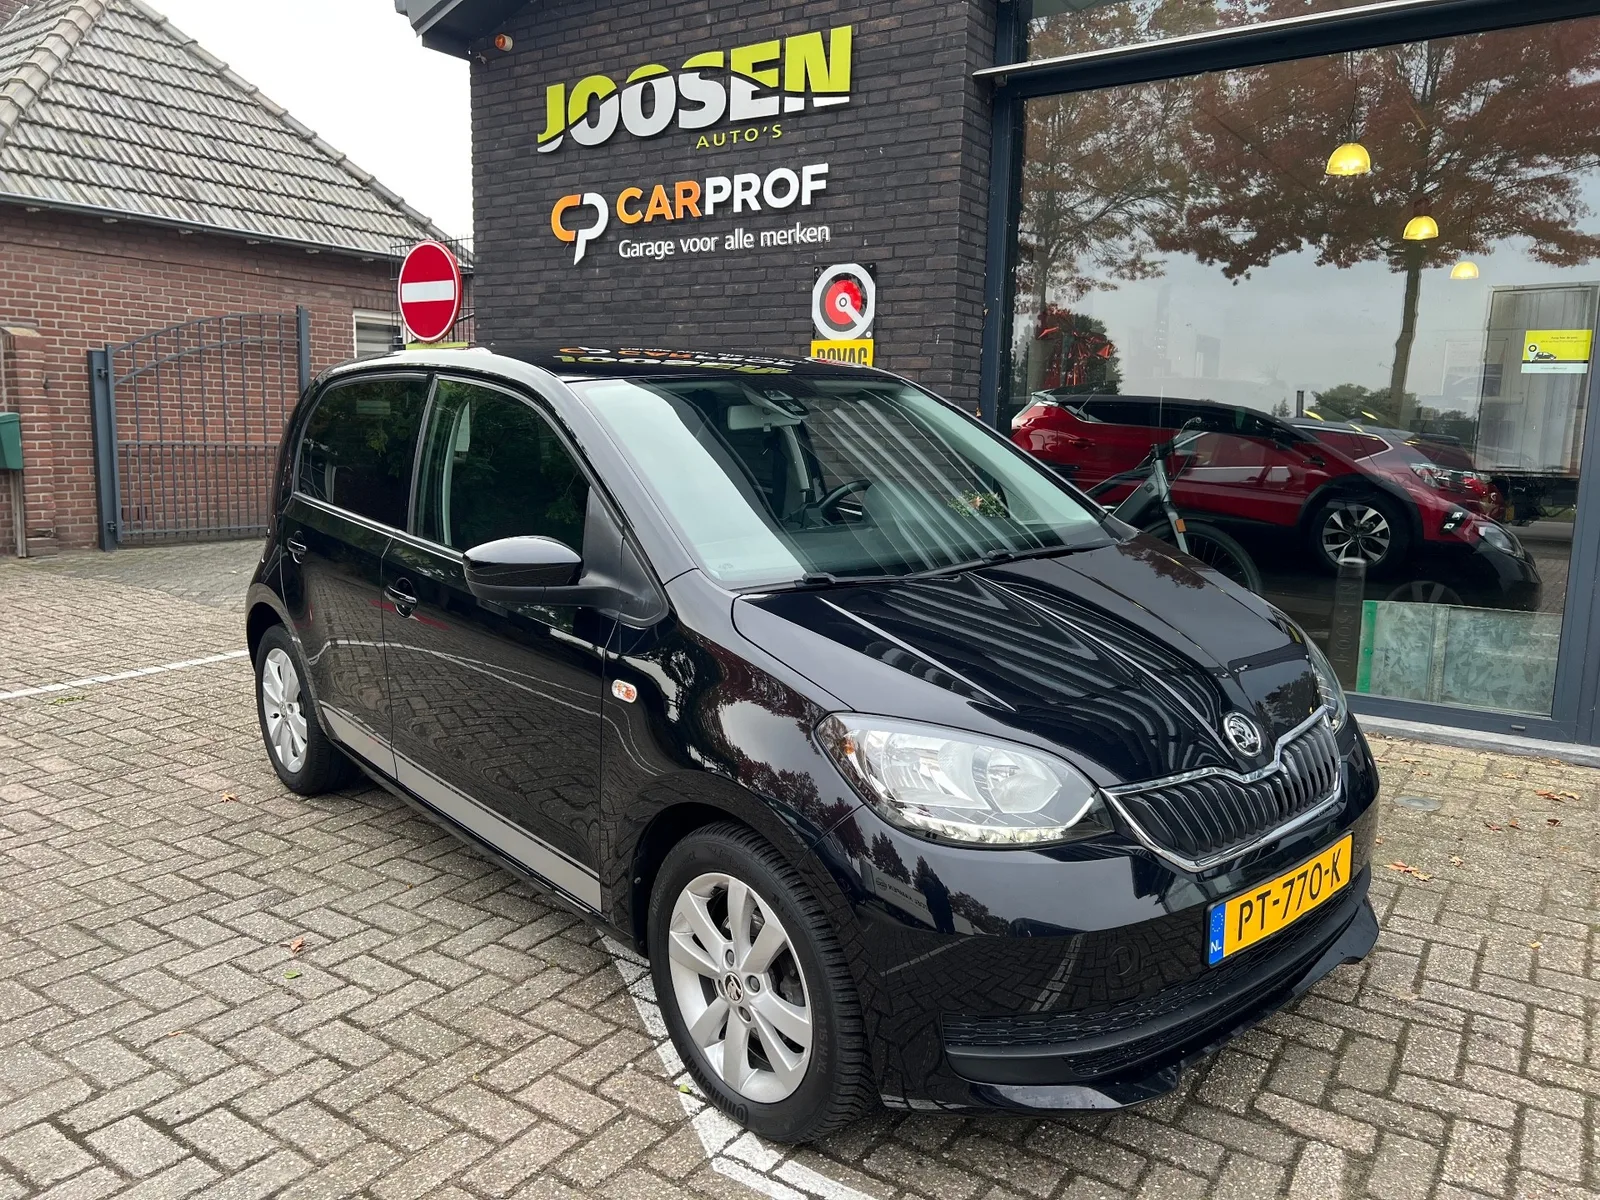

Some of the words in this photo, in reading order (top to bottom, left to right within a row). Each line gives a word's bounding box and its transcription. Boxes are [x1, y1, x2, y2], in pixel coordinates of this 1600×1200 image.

[537, 25, 853, 153] JOOSEN
[696, 124, 783, 149] AUTO'S
[616, 163, 829, 224] CARPROF
[618, 239, 675, 260] Garage
[680, 235, 719, 253] voor
[724, 228, 754, 250] alle
[760, 221, 830, 247] merken
[1237, 848, 1342, 942] PT-770-K
[1210, 939, 1223, 954] NL
